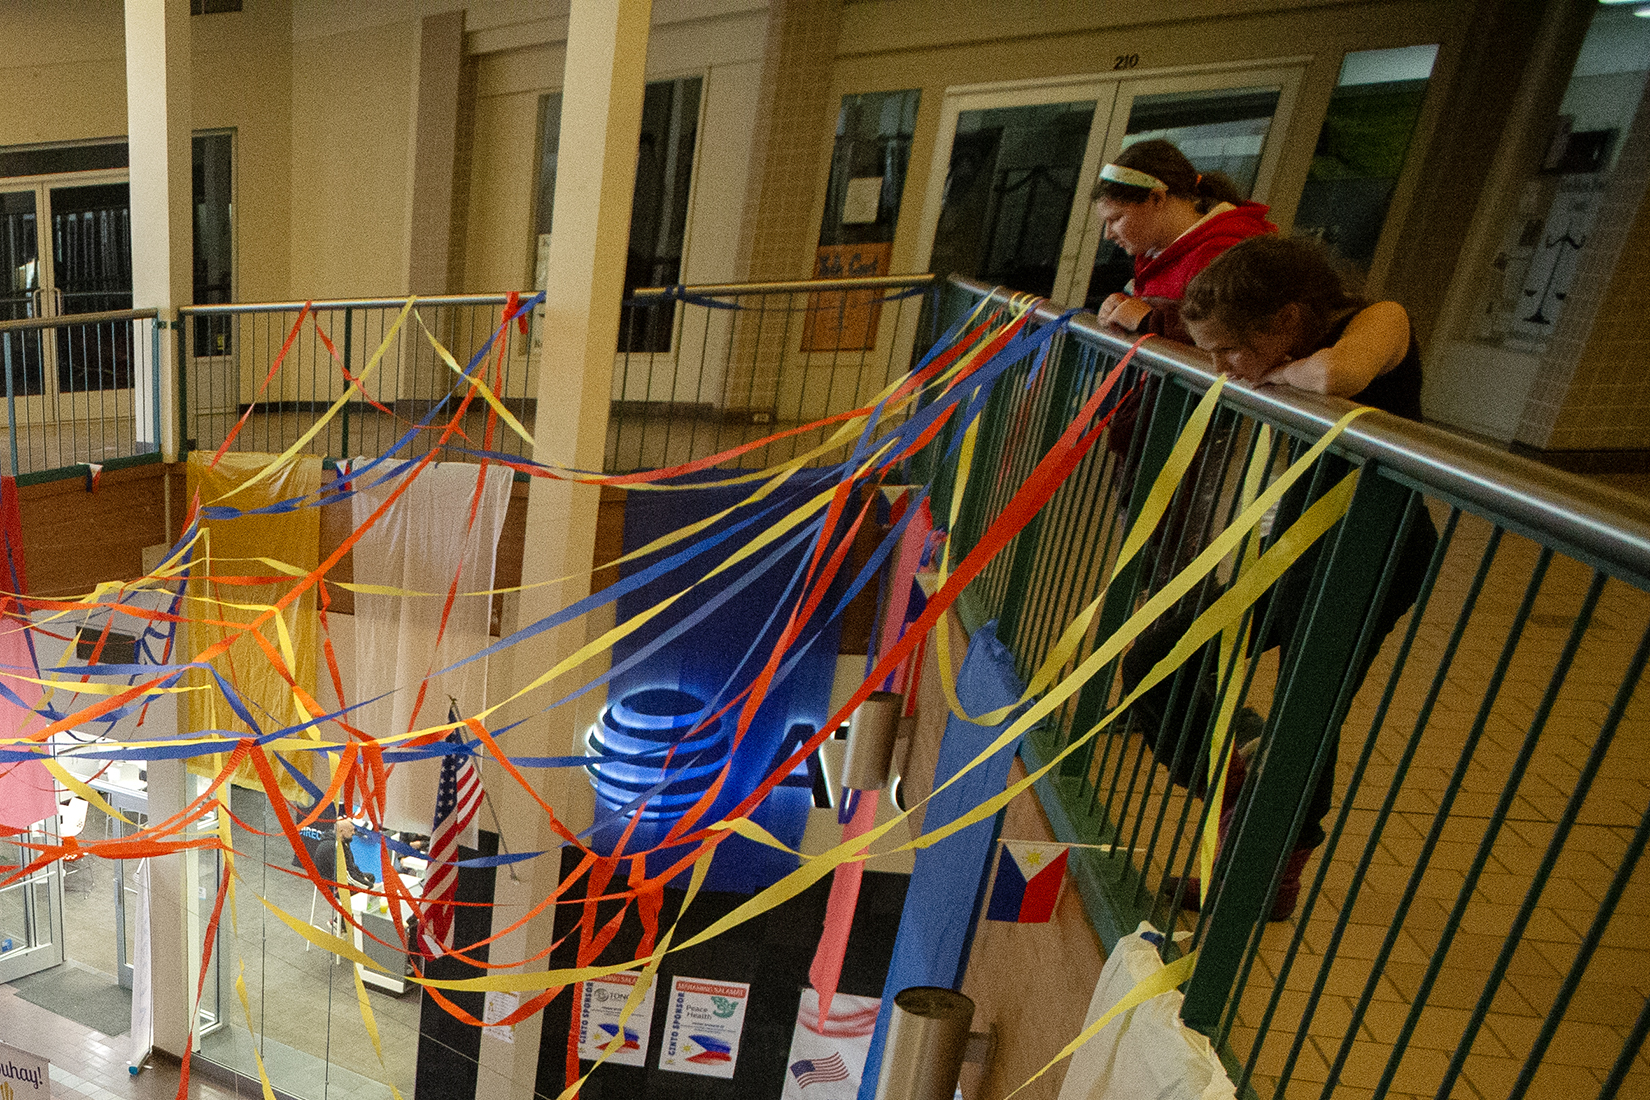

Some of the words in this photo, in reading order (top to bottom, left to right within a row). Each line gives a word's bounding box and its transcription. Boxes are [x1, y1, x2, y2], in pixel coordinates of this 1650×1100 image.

[1113, 53, 1139, 70] 210
[582, 982, 593, 1018] SPONSOR
[686, 1004, 708, 1012] Peace
[672, 992, 685, 1029] SPONSOR
[687, 1012, 712, 1020] Health
